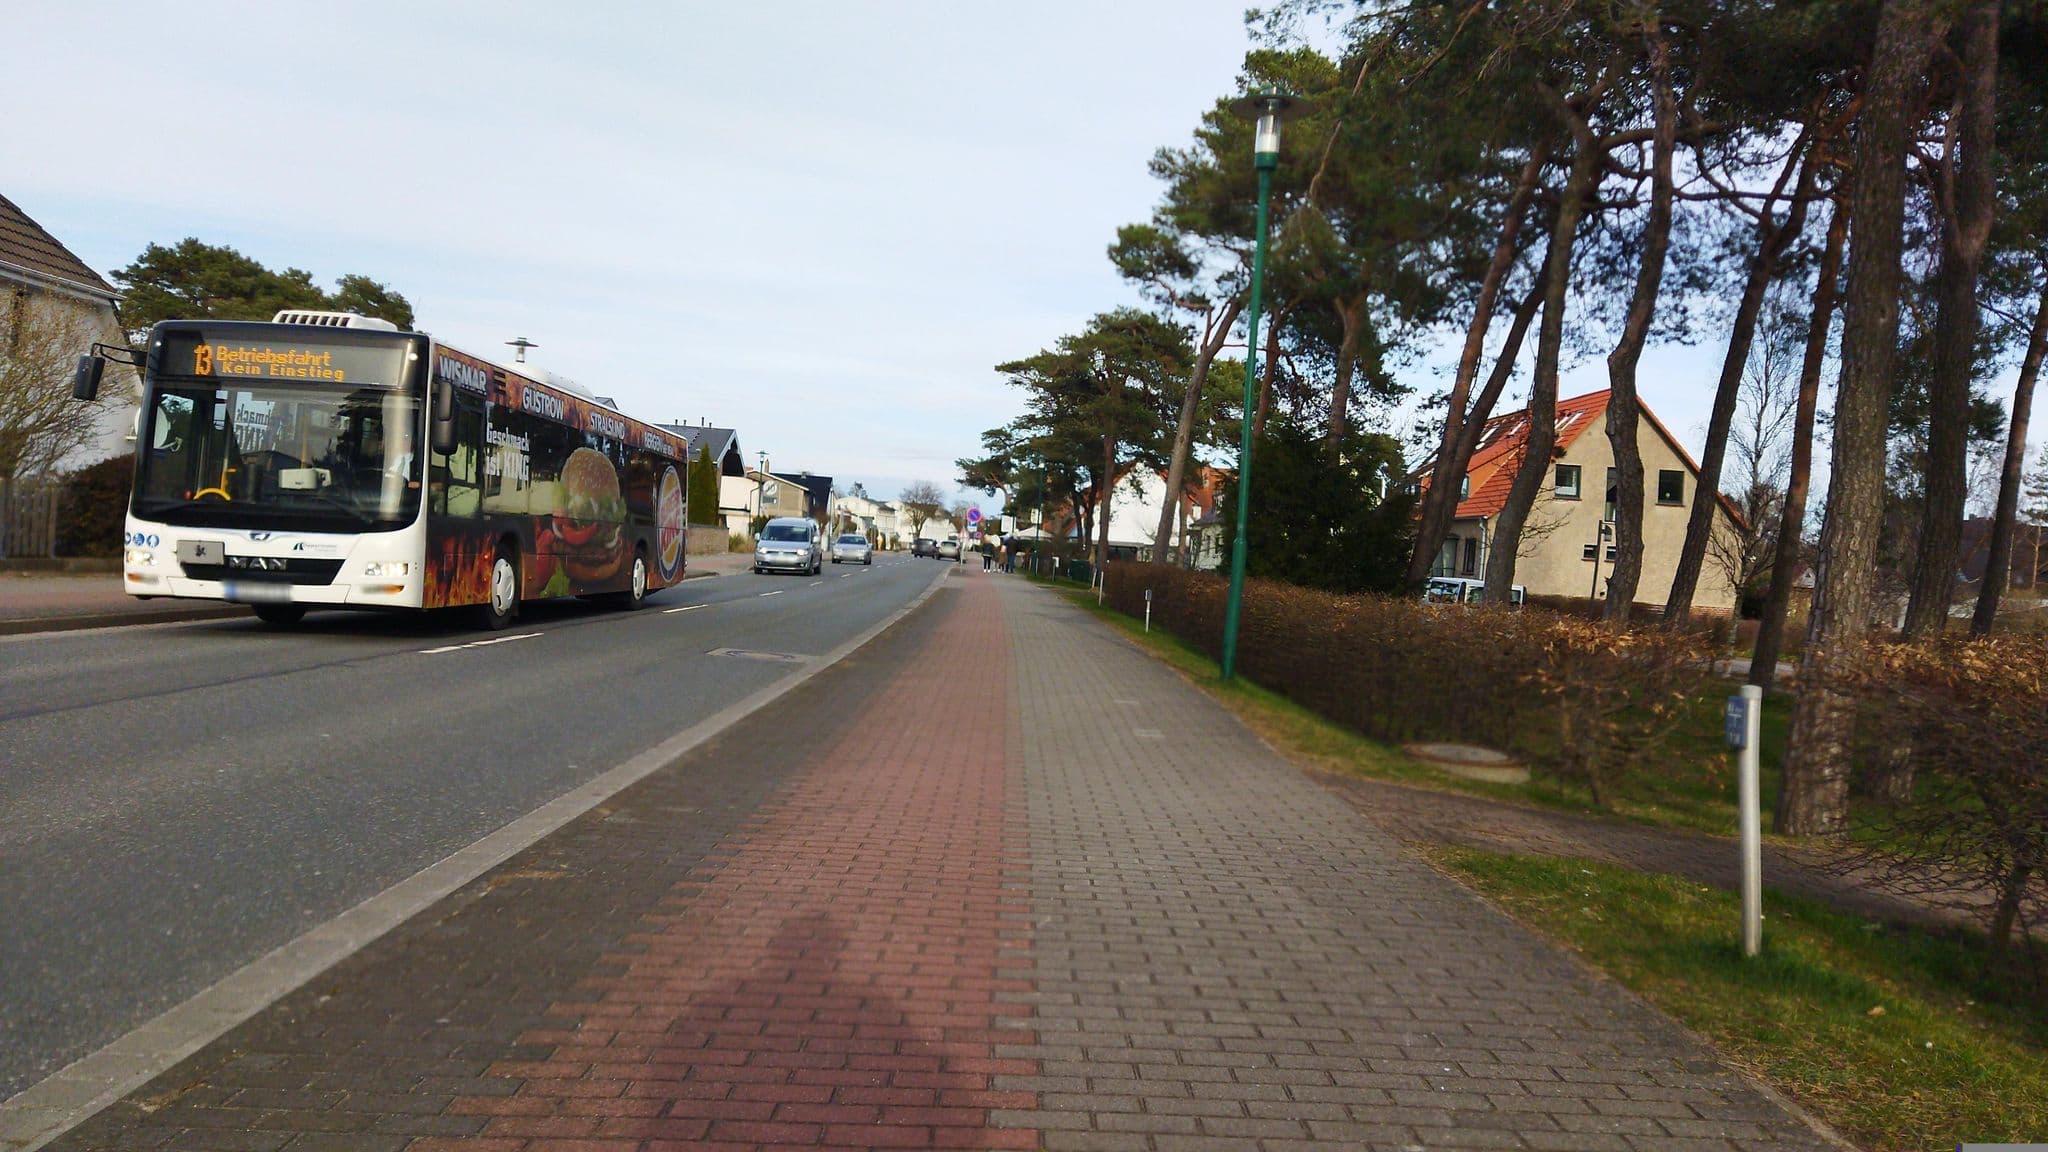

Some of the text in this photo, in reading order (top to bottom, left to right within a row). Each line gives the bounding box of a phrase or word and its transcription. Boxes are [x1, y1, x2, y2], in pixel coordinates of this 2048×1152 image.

[193, 344, 213, 376] 13
[216, 345, 331, 367] Betriebsfahrt
[222, 361, 345, 382] Kein Einstieg
[439, 355, 487, 396] WISMAR
[486, 422, 530, 452] Geschmack
[590, 412, 626, 440] STRALSUND
[502, 452, 530, 481] KING
[228, 556, 289, 571] MAN
